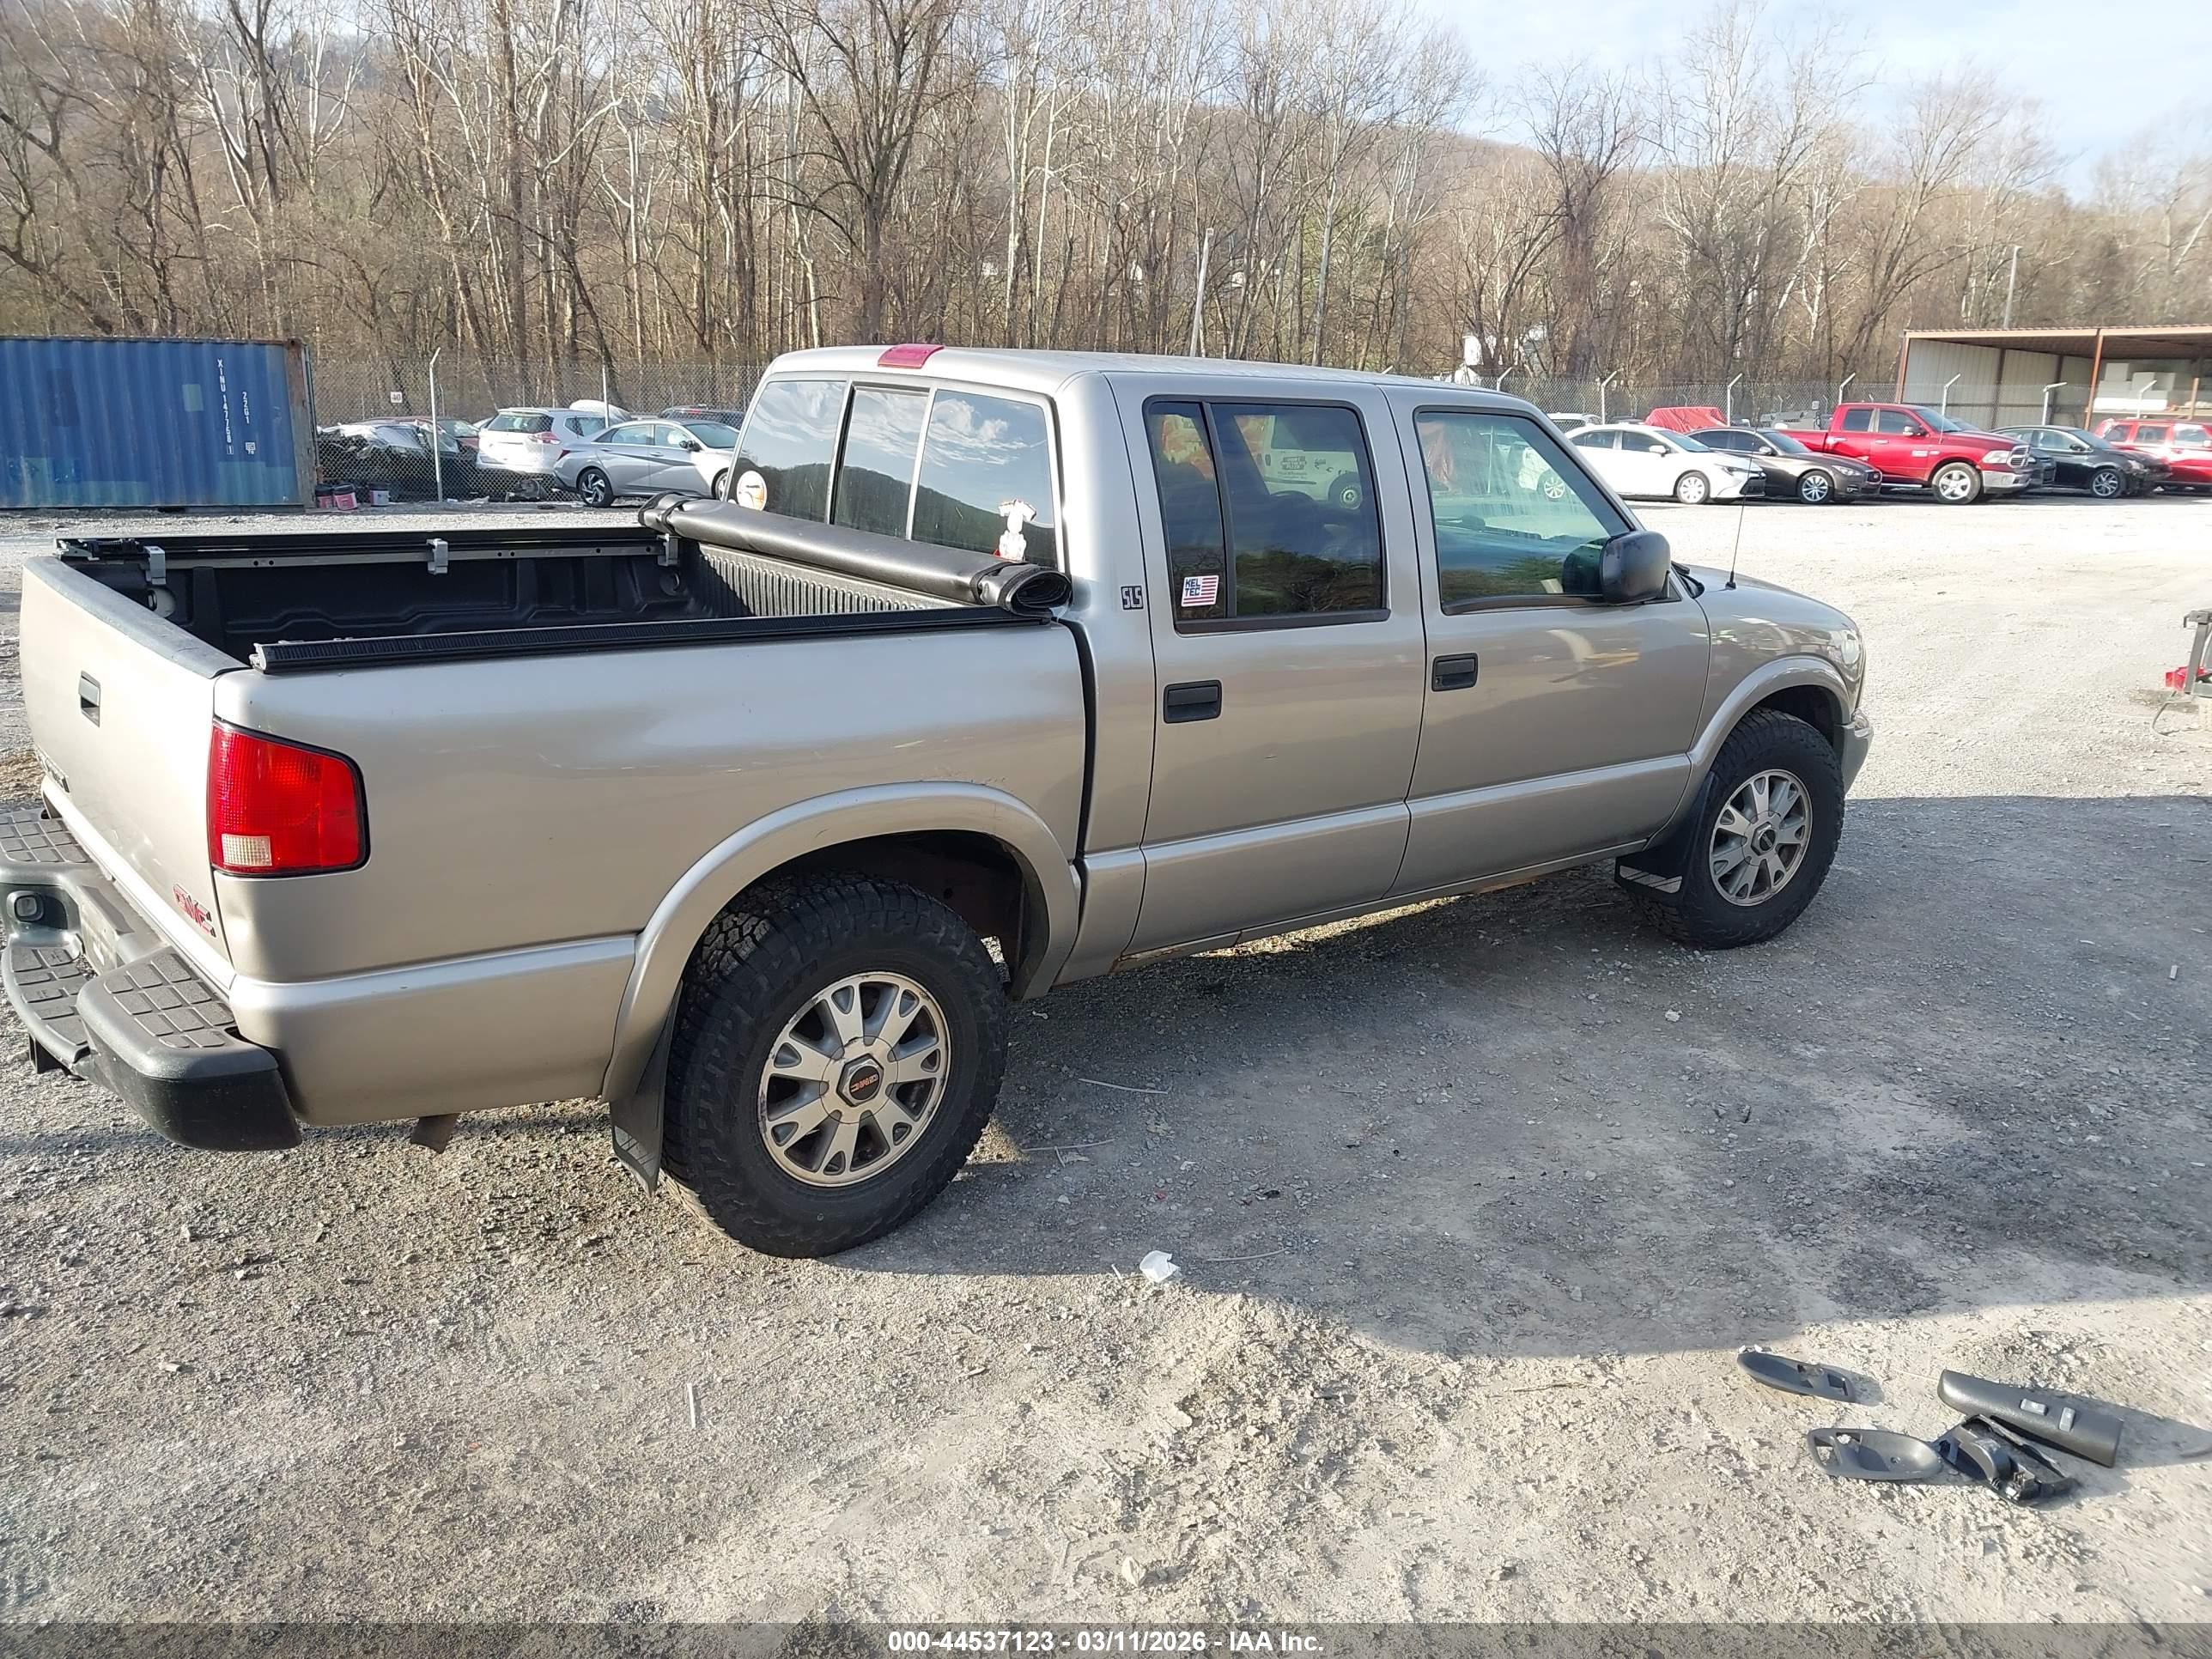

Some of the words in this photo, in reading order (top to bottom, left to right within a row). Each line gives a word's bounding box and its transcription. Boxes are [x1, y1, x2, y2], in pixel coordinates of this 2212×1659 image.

[1185, 578, 1201, 587] KEL
[1184, 587, 1200, 597] TEC
[1121, 587, 1144, 609] SLS
